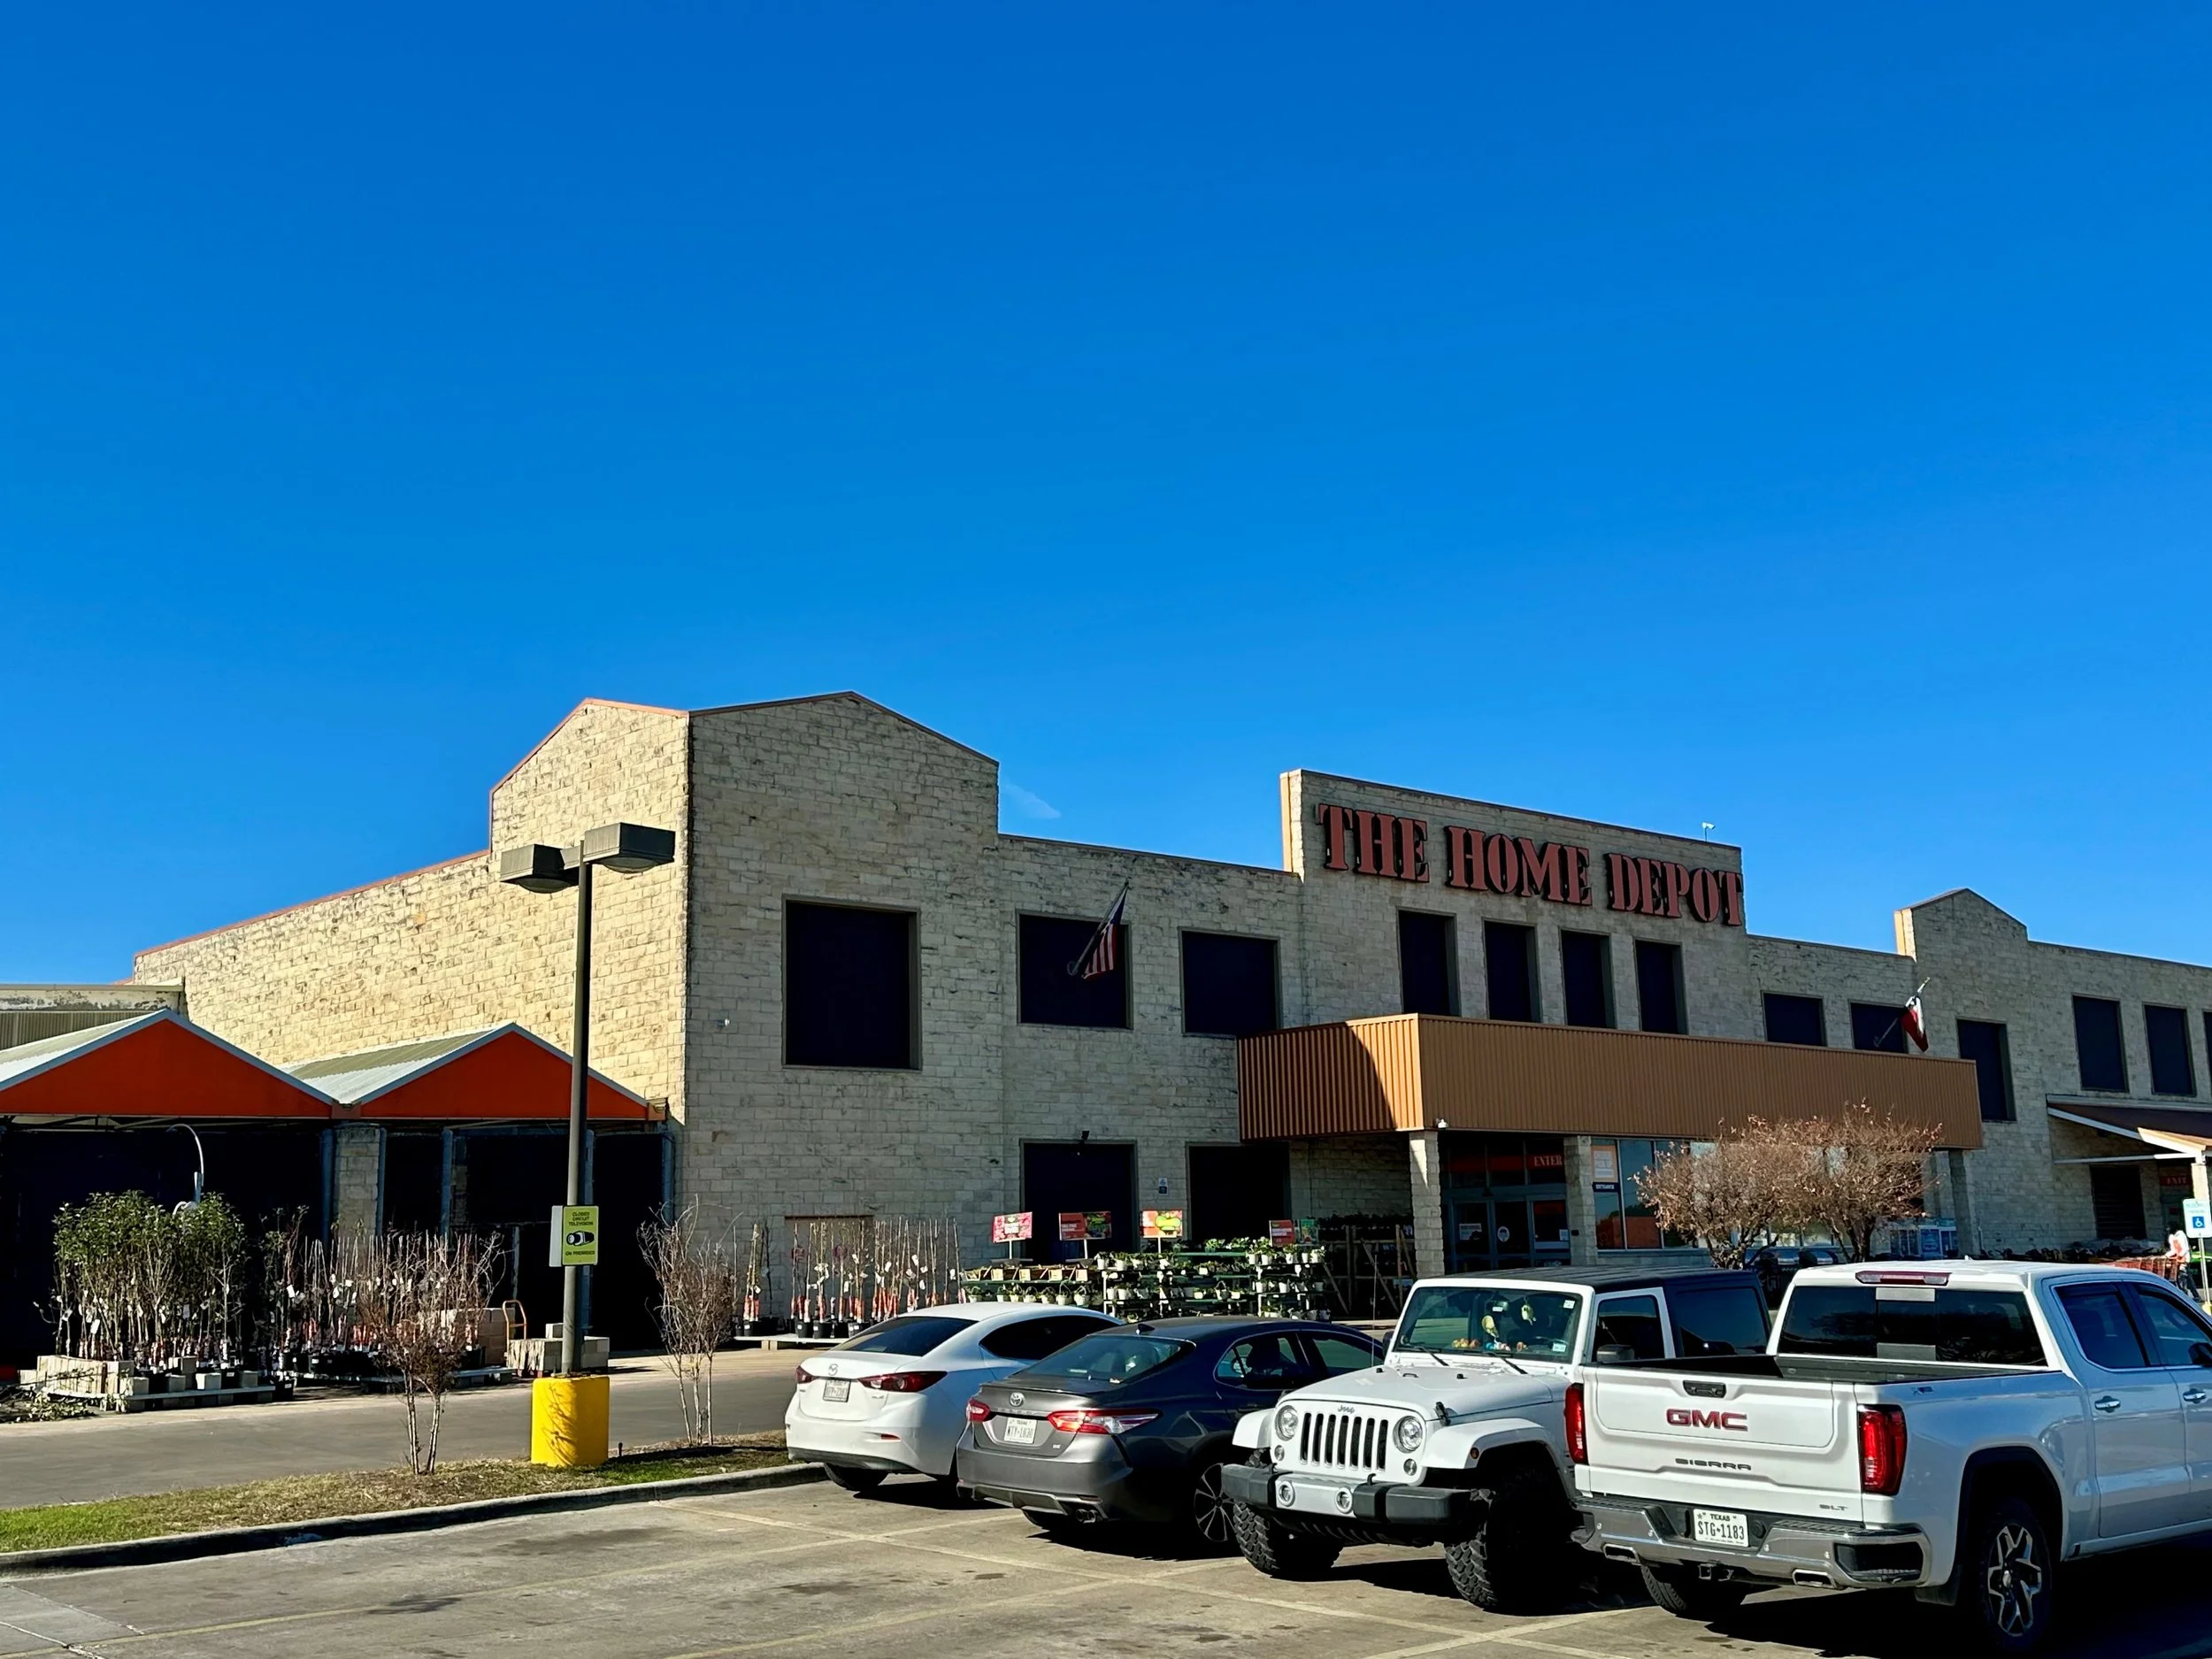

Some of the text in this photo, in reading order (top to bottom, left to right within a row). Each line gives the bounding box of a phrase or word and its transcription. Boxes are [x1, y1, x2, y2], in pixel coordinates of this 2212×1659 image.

[1317, 803, 1744, 926] THE HOME DEPOT
[1534, 1155, 1563, 1166] ENTER
[1666, 1409, 1748, 1432] GMC
[1675, 1458, 1752, 1471] SIERRA
[1709, 1513, 1731, 1522] TEXAS
